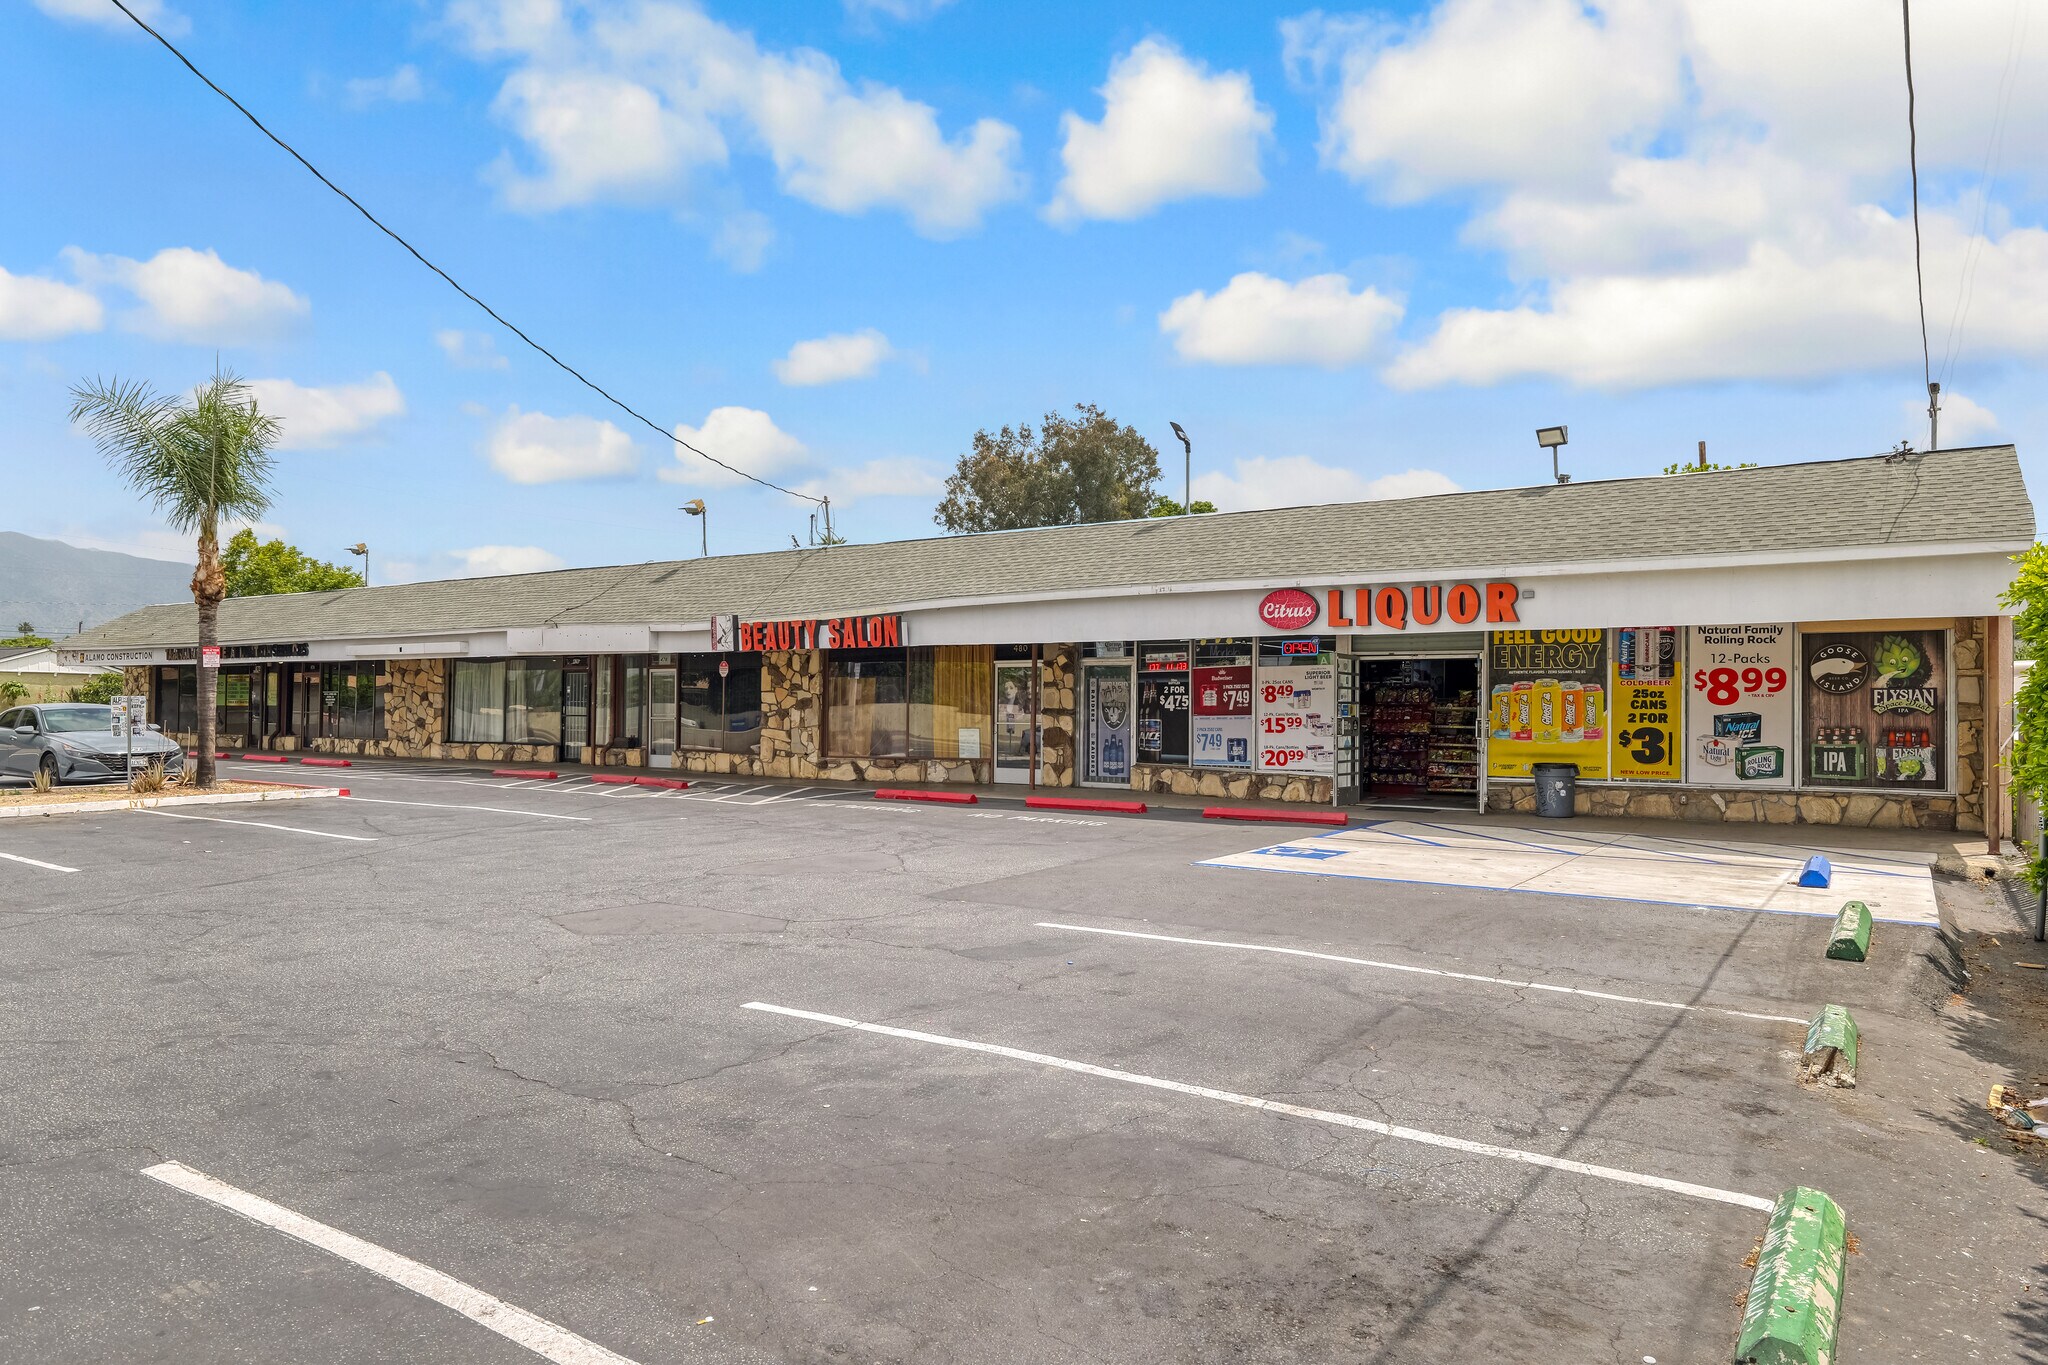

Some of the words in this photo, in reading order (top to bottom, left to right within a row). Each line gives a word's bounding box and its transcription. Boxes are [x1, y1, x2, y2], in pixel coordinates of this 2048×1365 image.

[1263, 603, 1313, 619] Citrus
[1328, 583, 1520, 630] LIQUOR
[741, 619, 817, 651] BEAUTY
[828, 615, 898, 649] SALON
[1494, 630, 1535, 645] FEEL
[1541, 628, 1602, 644] GOOD
[1698, 626, 1742, 635] Natural
[1745, 625, 1784, 636] Family
[1704, 635, 1744, 646] Rolling
[1747, 635, 1777, 644] Rock
[1013, 645, 1028, 653] 480
[1283, 642, 1317, 654] OPEN
[1620, 640, 1630, 663] Natty
[1820, 646, 1859, 659] GOOSE
[84, 653, 105, 661] ALAMO
[106, 651, 153, 660] CONSTRUCTION
[1494, 643, 1602, 670] ENERGY
[1711, 653, 1771, 664] 12-Packs
[1164, 686, 1169, 694] 2
[1170, 686, 1185, 694] FOR
[1819, 677, 1860, 691] ISLAND
[1632, 689, 1664, 699] 25oz
[1873, 689, 1934, 706] ELYSIAN
[1630, 700, 1667, 709] CANS
[1628, 713, 1636, 723] 2
[1639, 713, 1668, 723] FOR
[1725, 720, 1760, 732] Natural
[1738, 729, 1757, 738] ICE
[1703, 745, 1730, 756] Natural
[1892, 748, 1931, 760] ELYSIAN
[1747, 756, 1772, 766] ROLLING
[1823, 752, 1847, 772] IPA
